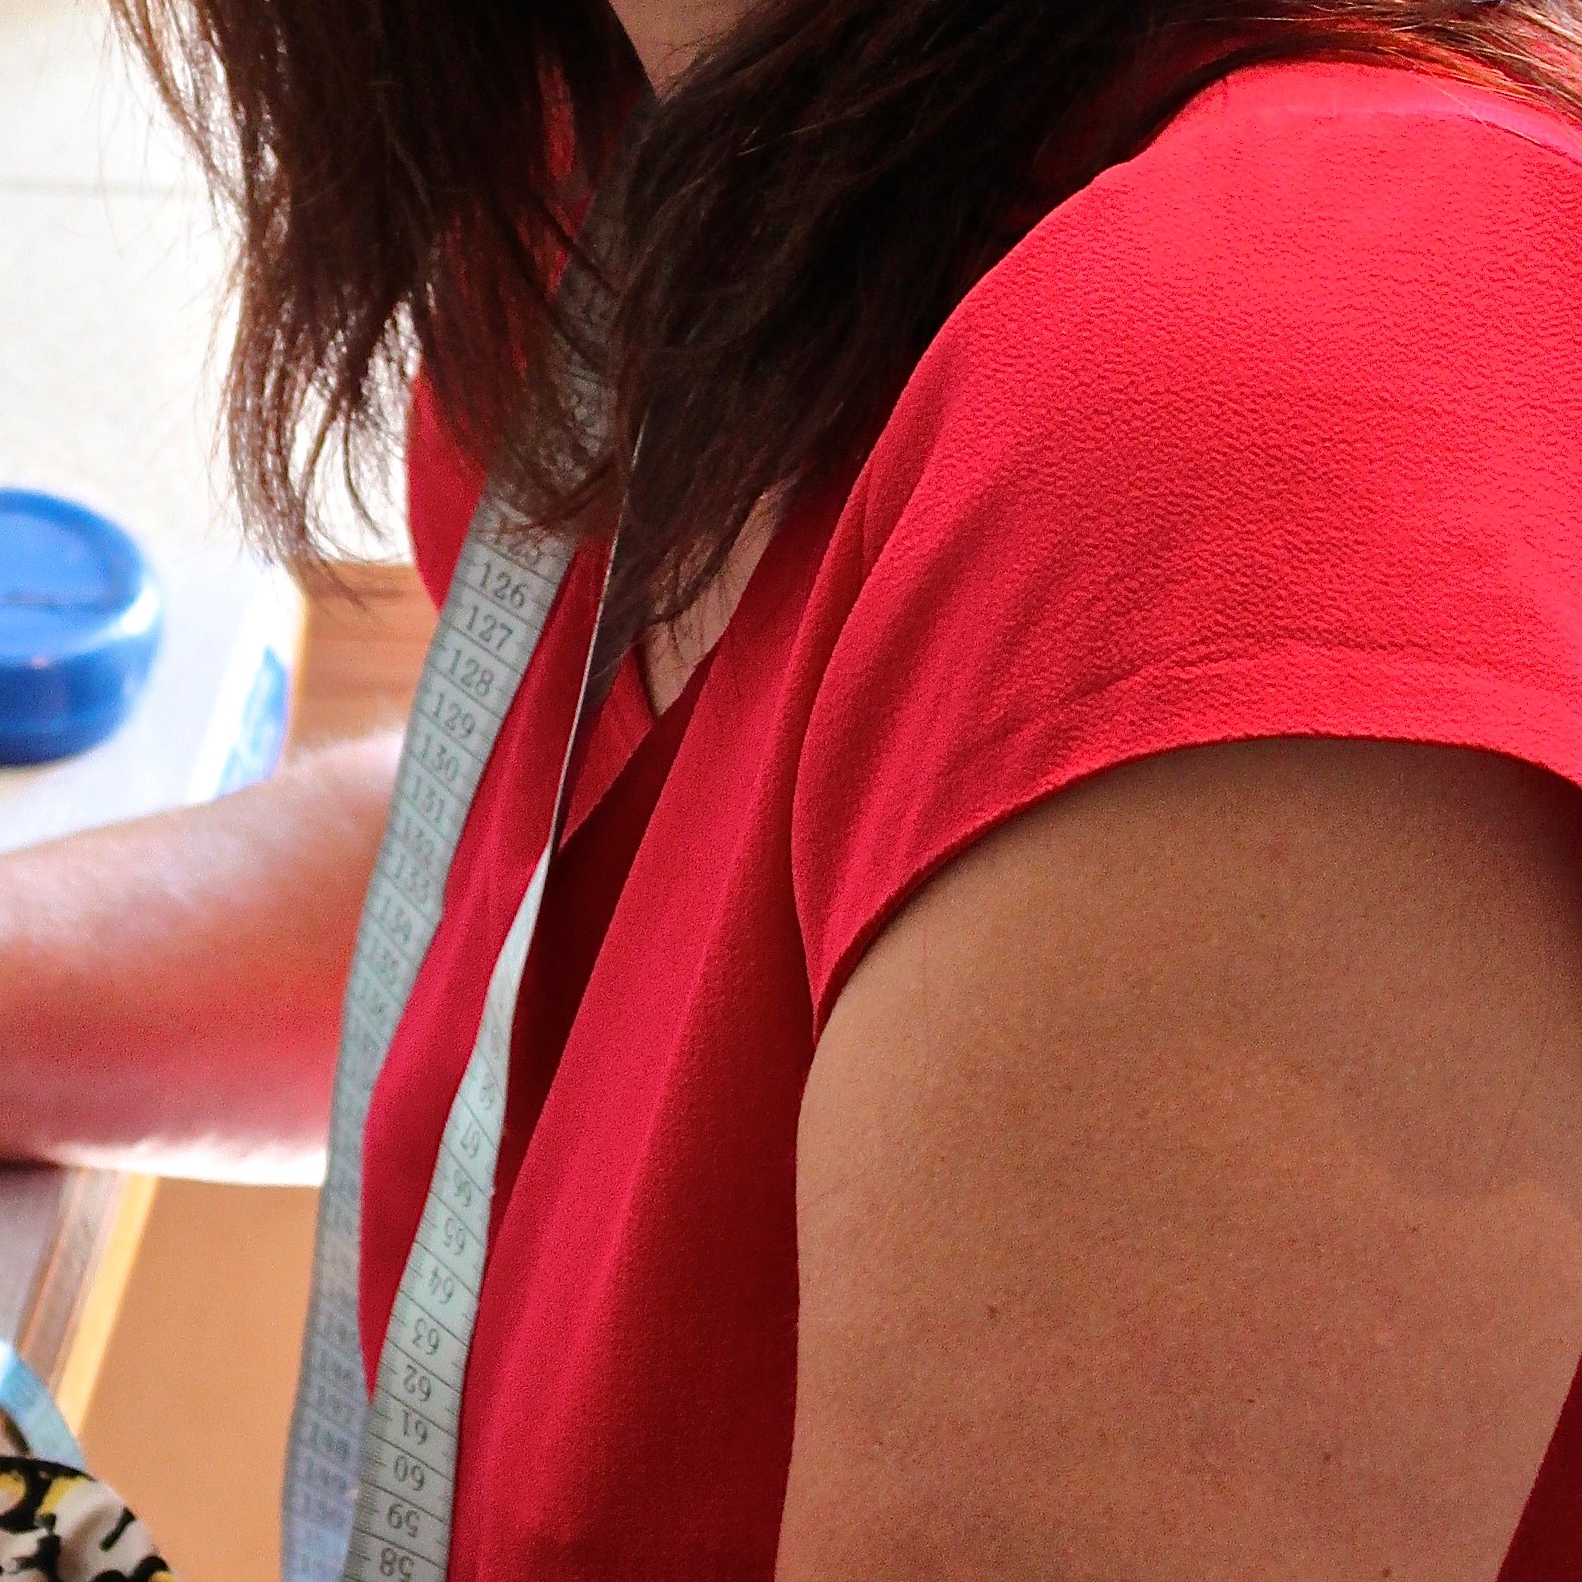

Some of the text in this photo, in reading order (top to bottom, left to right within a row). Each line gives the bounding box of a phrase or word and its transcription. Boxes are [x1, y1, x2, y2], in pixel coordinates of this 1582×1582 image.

[480, 561, 529, 609] 126
[467, 605, 513, 650] 127
[449, 649, 494, 697] 128
[433, 692, 476, 739] 129
[421, 734, 460, 782] 130
[442, 1217, 467, 1256] 65
[428, 1268, 455, 1305] 64
[412, 1318, 440, 1356] 63
[403, 1363, 432, 1402] 62
[402, 1409, 428, 1446] 61
[394, 1455, 425, 1492] 60
[387, 1503, 420, 1538] 59
[379, 1547, 415, 1582] 58
